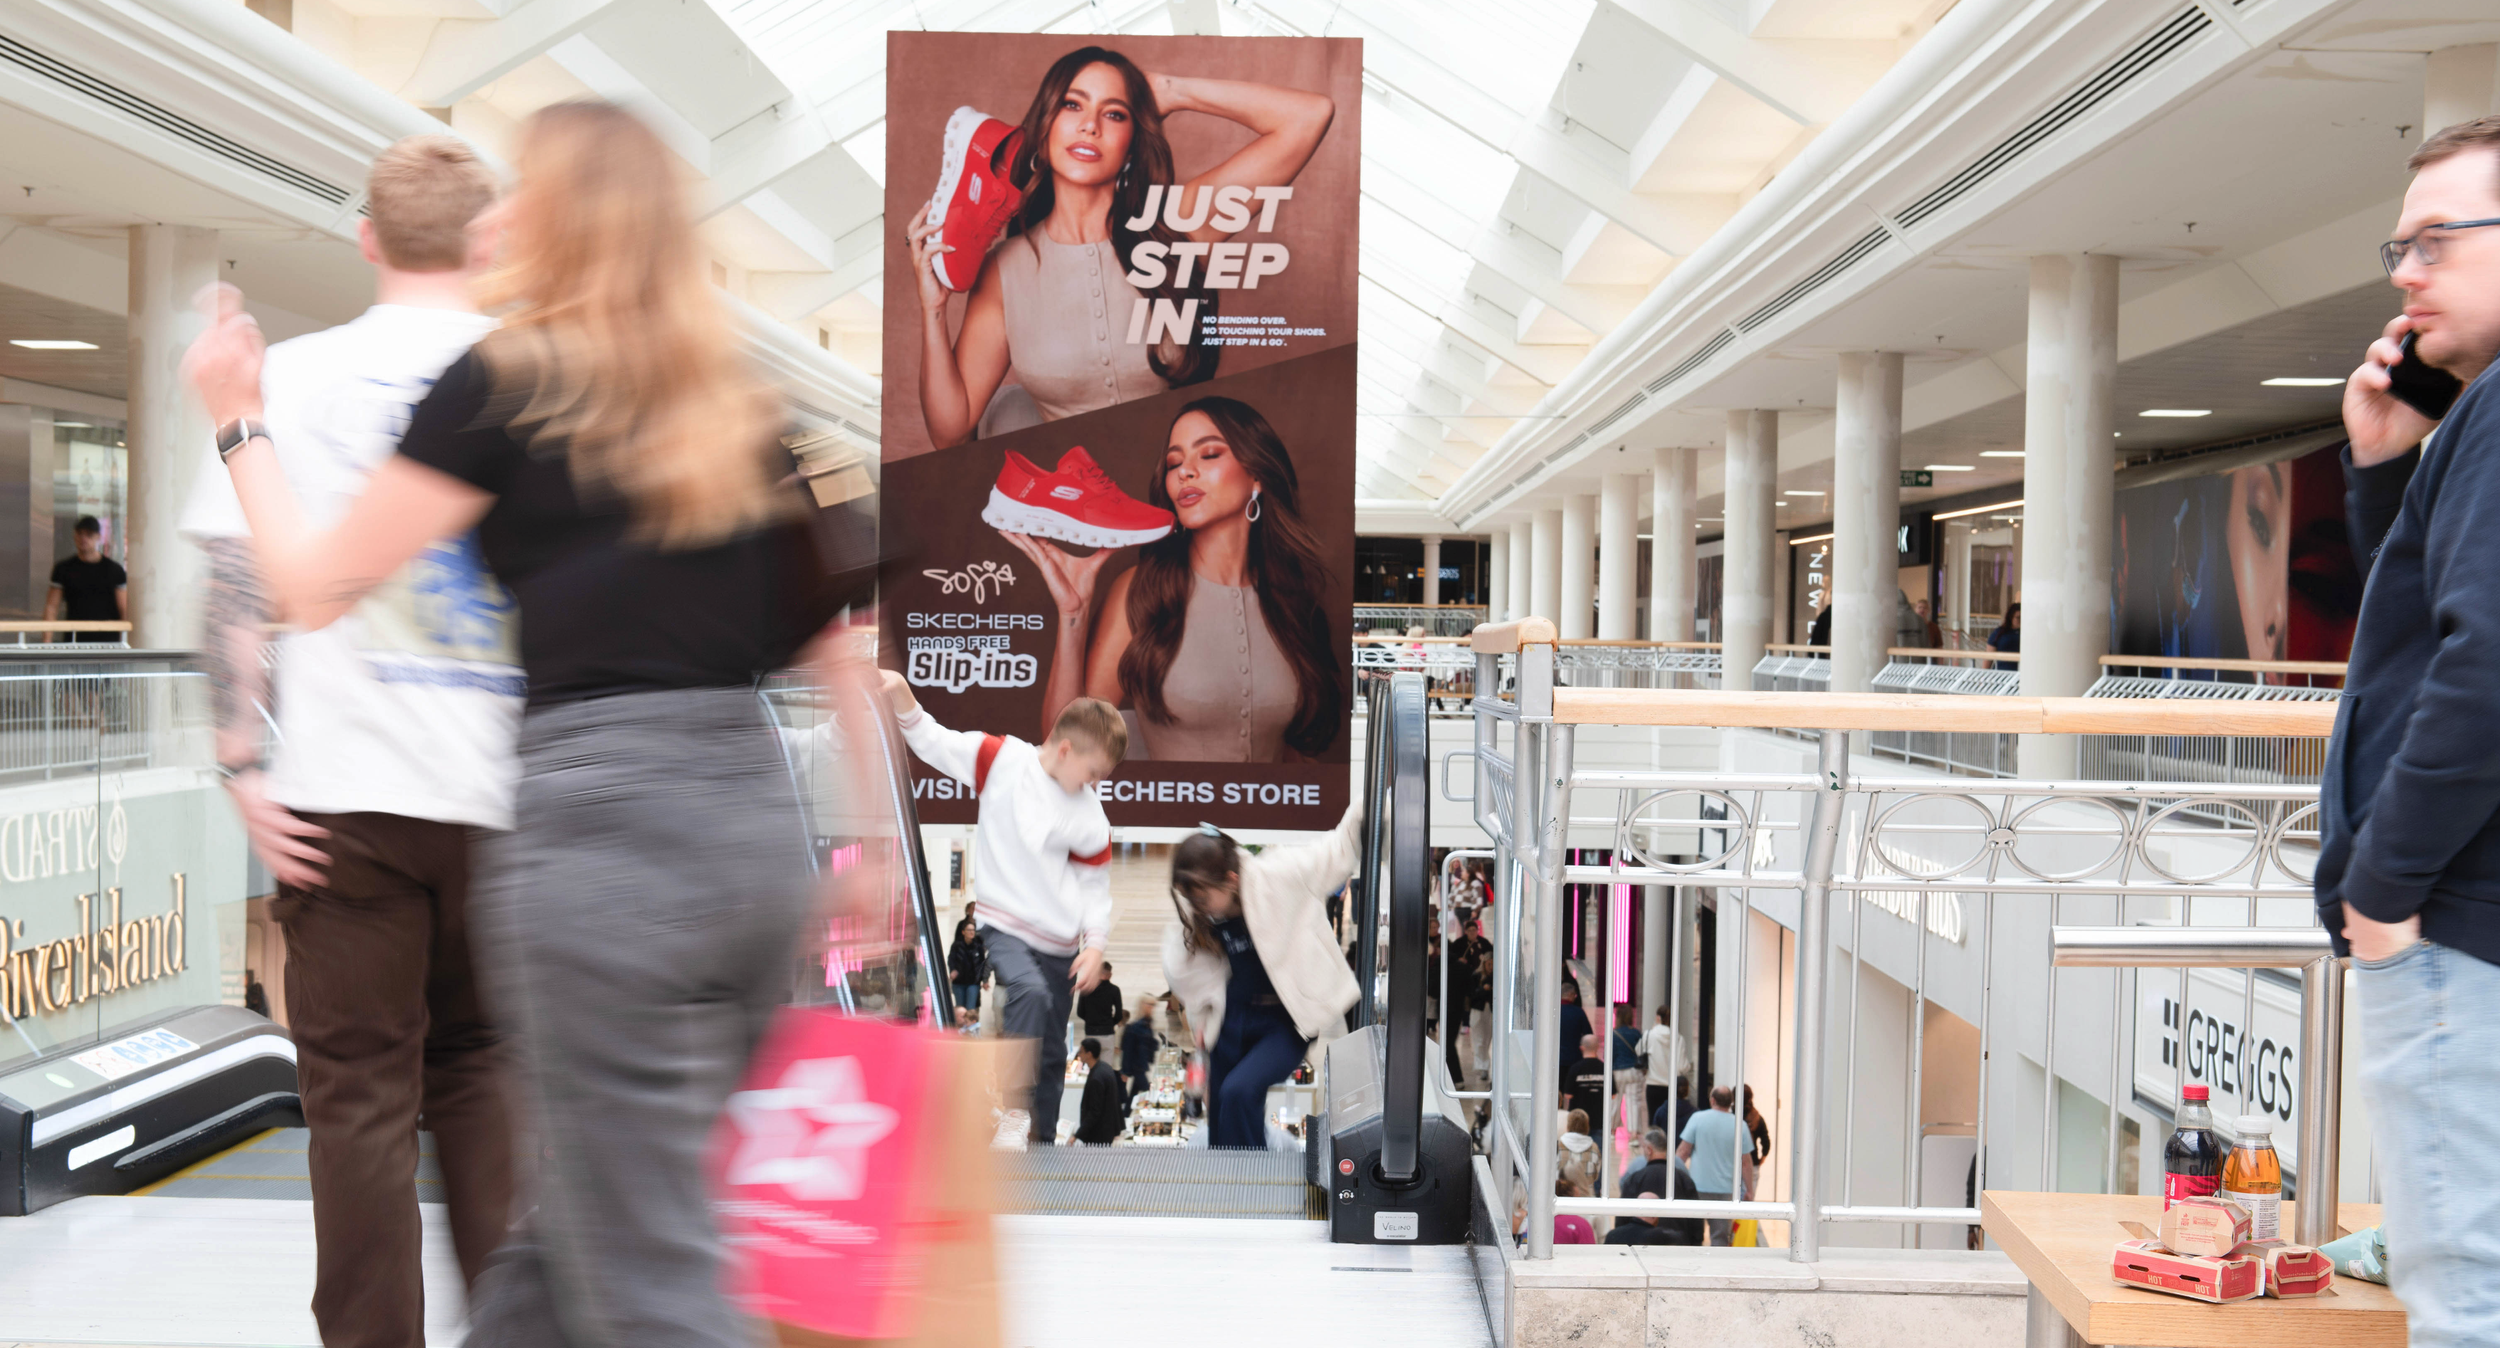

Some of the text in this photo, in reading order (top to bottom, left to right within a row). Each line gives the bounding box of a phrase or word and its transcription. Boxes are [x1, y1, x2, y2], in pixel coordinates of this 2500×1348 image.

[1124, 184, 1294, 233] JUST
[1125, 240, 1290, 290] STEP
[1125, 298, 1199, 345] IN
[1202, 316, 1287, 325] NO BENDING OVER.
[1201, 338, 1225, 346] JUST
[1225, 338, 1249, 346] STEP
[1249, 338, 1260, 346] IN
[1260, 338, 1267, 346] &
[1202, 327, 1327, 336] NO TOUCHING YOUR SHOES.
[1808, 552, 1824, 609] NEW
[906, 612, 1044, 630] SKECHERS
[968, 636, 1009, 650] FREE
[913, 651, 1032, 687] Slip-ins
[1096, 780, 1215, 803] ECHERS
[1222, 782, 1321, 805] STORE
[2187, 1008, 2293, 1122] GREGGS
[2147, 1274, 2163, 1286] HOT
[2194, 1283, 2210, 1295] HOT
